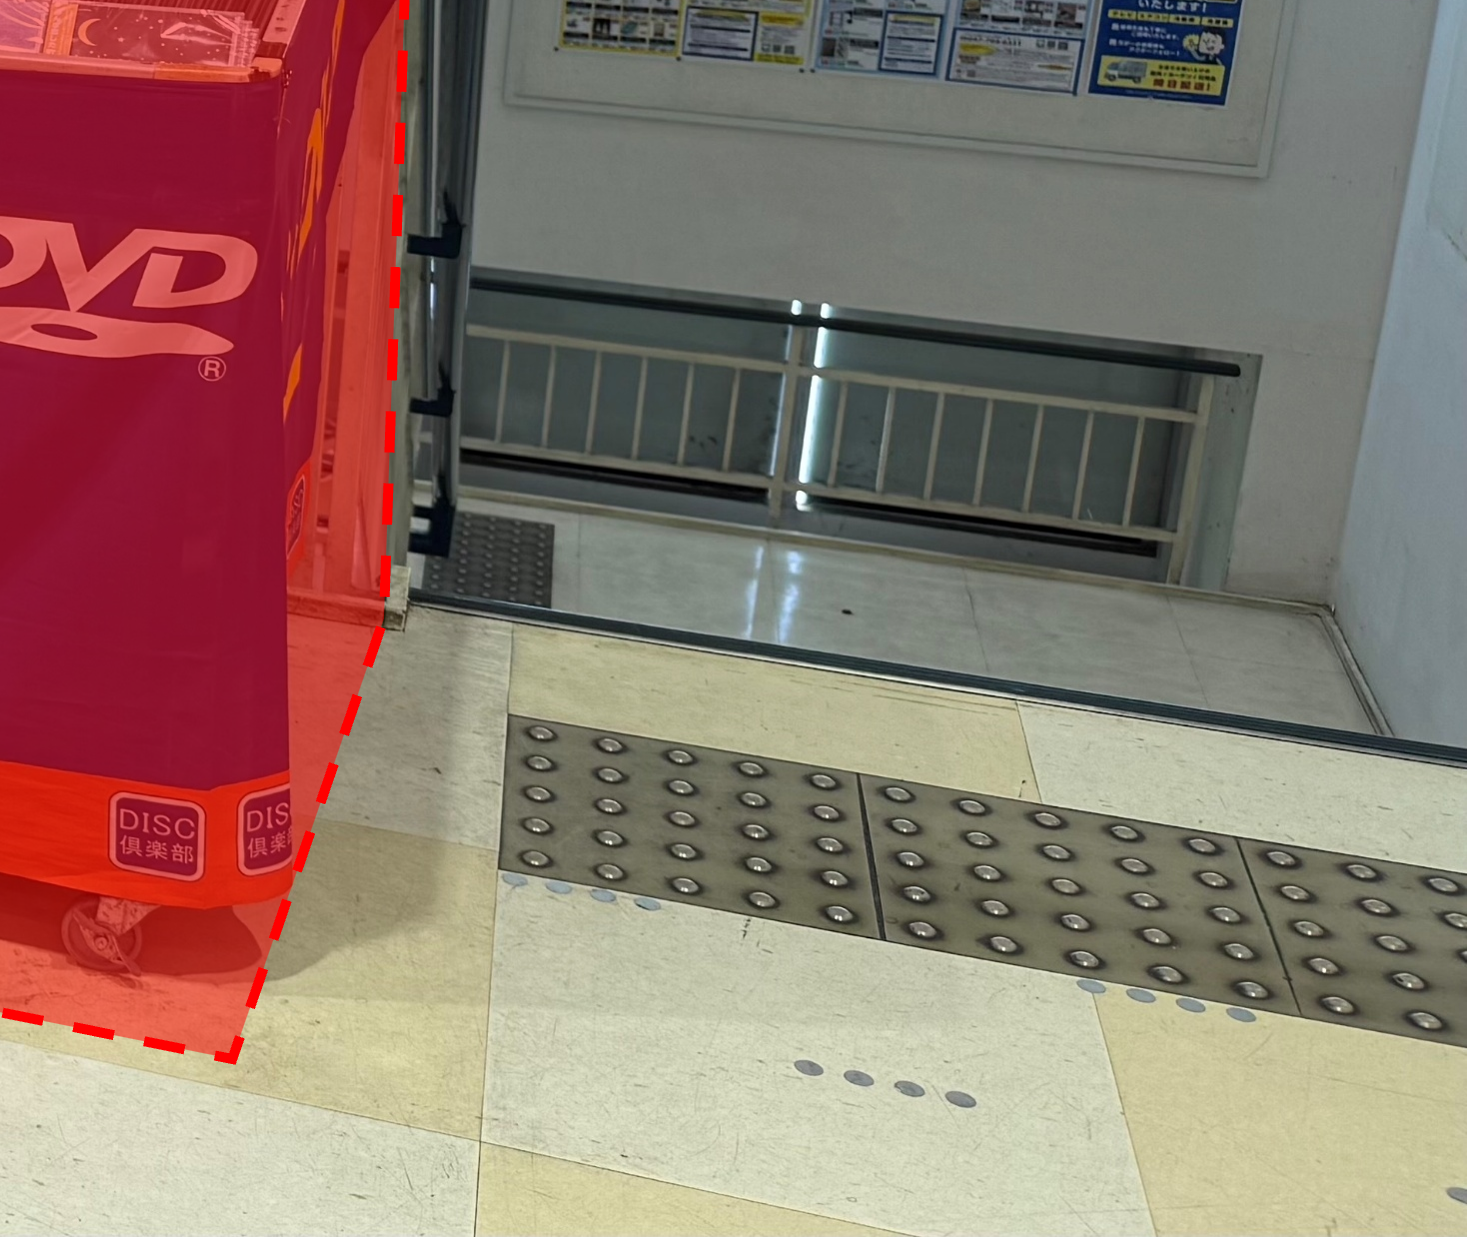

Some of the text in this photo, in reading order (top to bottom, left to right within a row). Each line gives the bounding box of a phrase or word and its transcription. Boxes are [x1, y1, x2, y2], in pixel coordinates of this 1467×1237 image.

[119, 807, 196, 840] DISC
[246, 801, 292, 833] DIS
[119, 834, 195, 865] 倶楽部
